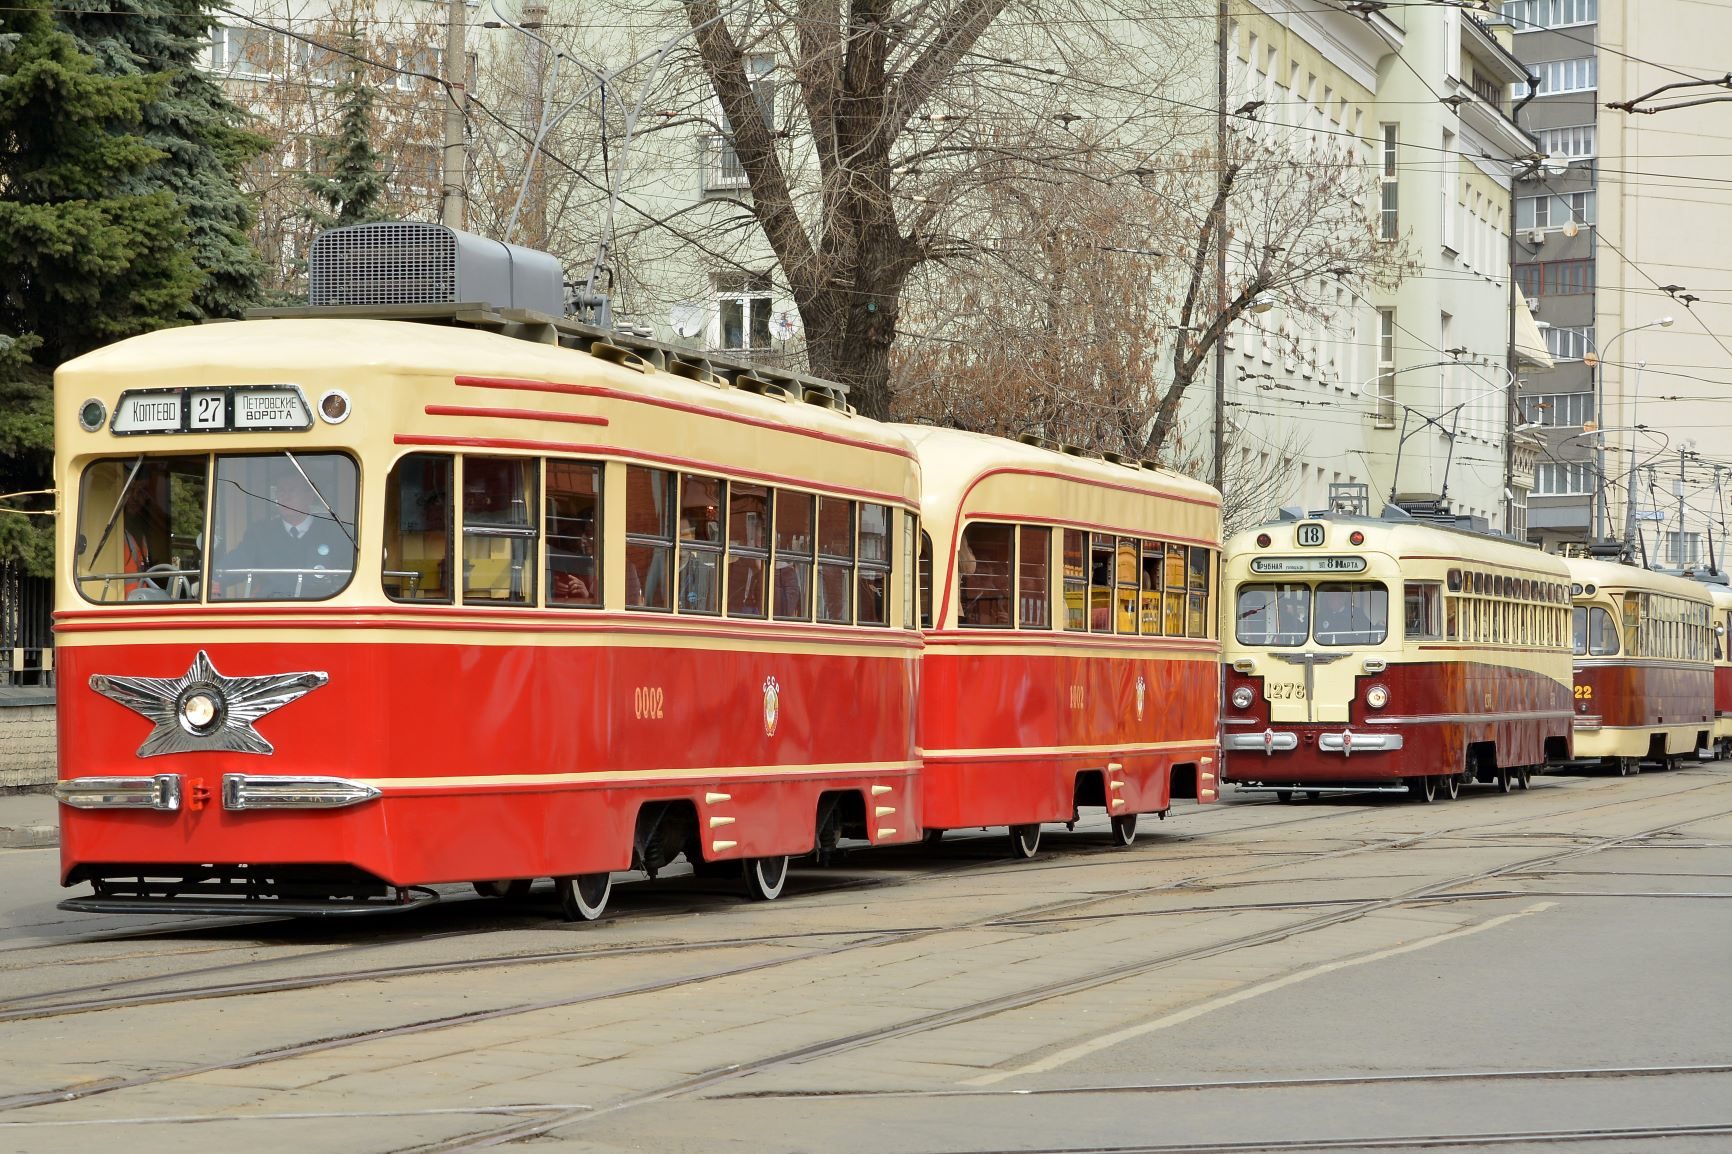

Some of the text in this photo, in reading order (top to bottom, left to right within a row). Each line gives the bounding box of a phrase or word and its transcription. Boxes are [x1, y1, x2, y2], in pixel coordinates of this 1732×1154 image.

[198, 397, 221, 423] 27
[243, 396, 296, 410] ПЕТРОВСКИЕ
[133, 401, 176, 423] КОПТЕВО
[246, 410, 292, 421] ВОРОТА
[1304, 527, 1319, 543] 18
[1255, 561, 1283, 570] ТРУБНАЯ
[1327, 558, 1334, 569] 8
[1335, 560, 1359, 569] МАРТА
[635, 686, 664, 719] 0002
